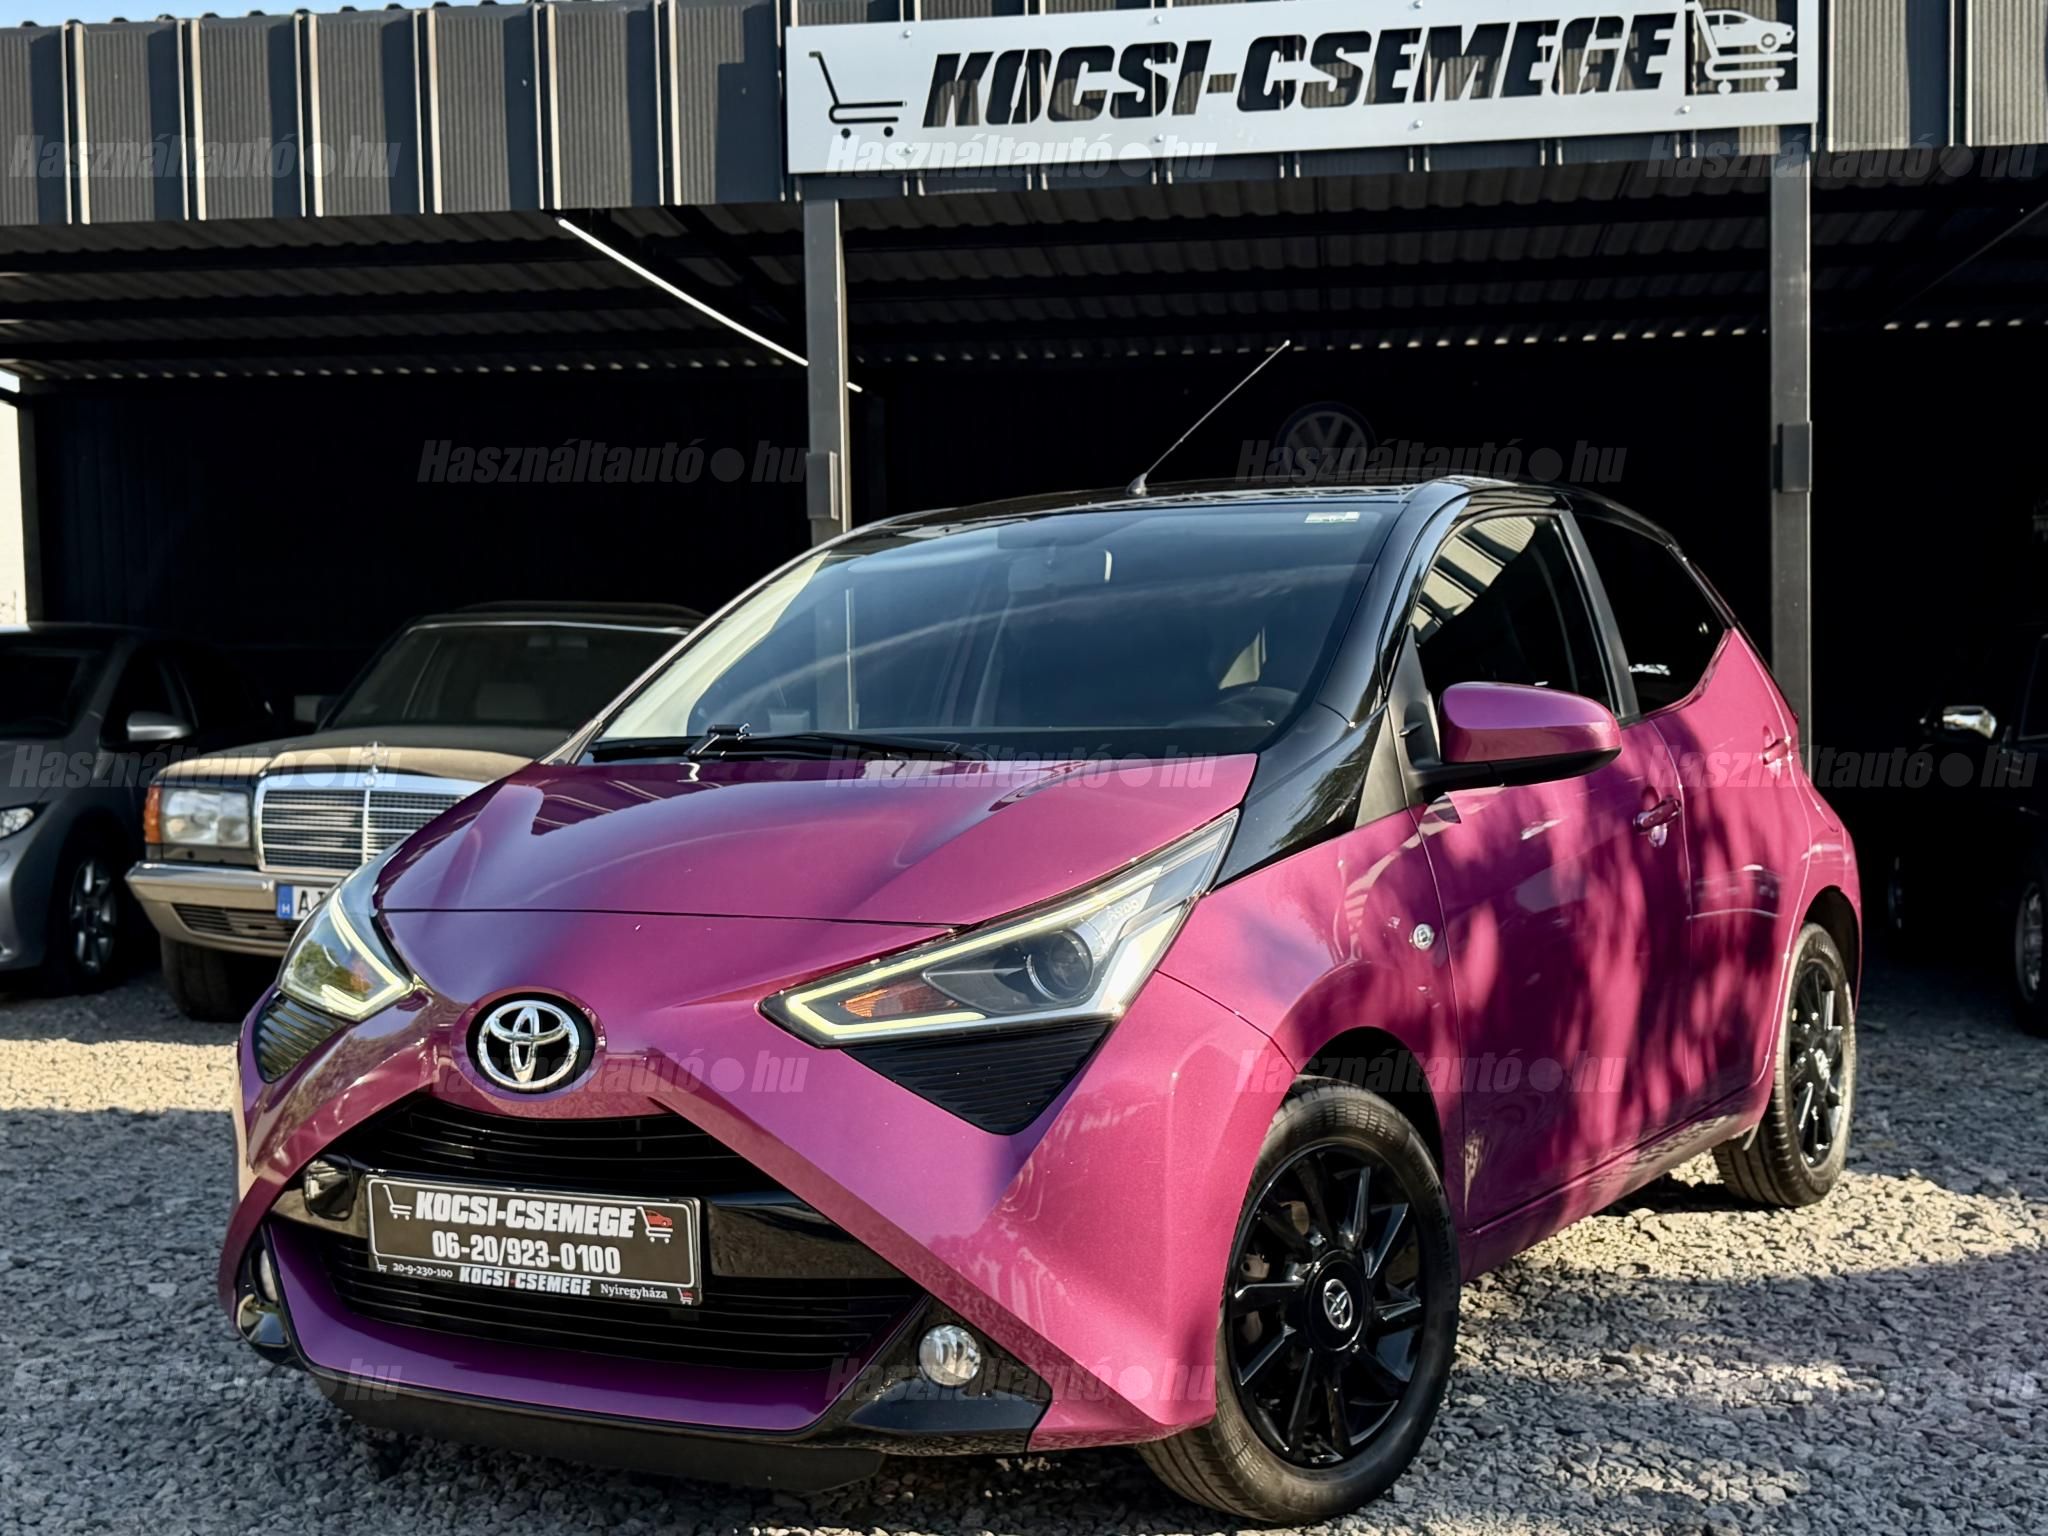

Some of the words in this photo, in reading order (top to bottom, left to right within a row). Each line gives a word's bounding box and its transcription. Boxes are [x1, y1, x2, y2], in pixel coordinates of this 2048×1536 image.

[922, 12, 1678, 129] KOCSI-CSEMEGE
[415, 1191, 637, 1239] KOCSI-CSEMEGE
[432, 1230, 622, 1275] 06-20/923-0100
[392, 1262, 454, 1279] 20-9-230-100
[458, 1265, 592, 1296] KOCSI-CSEMEGE
